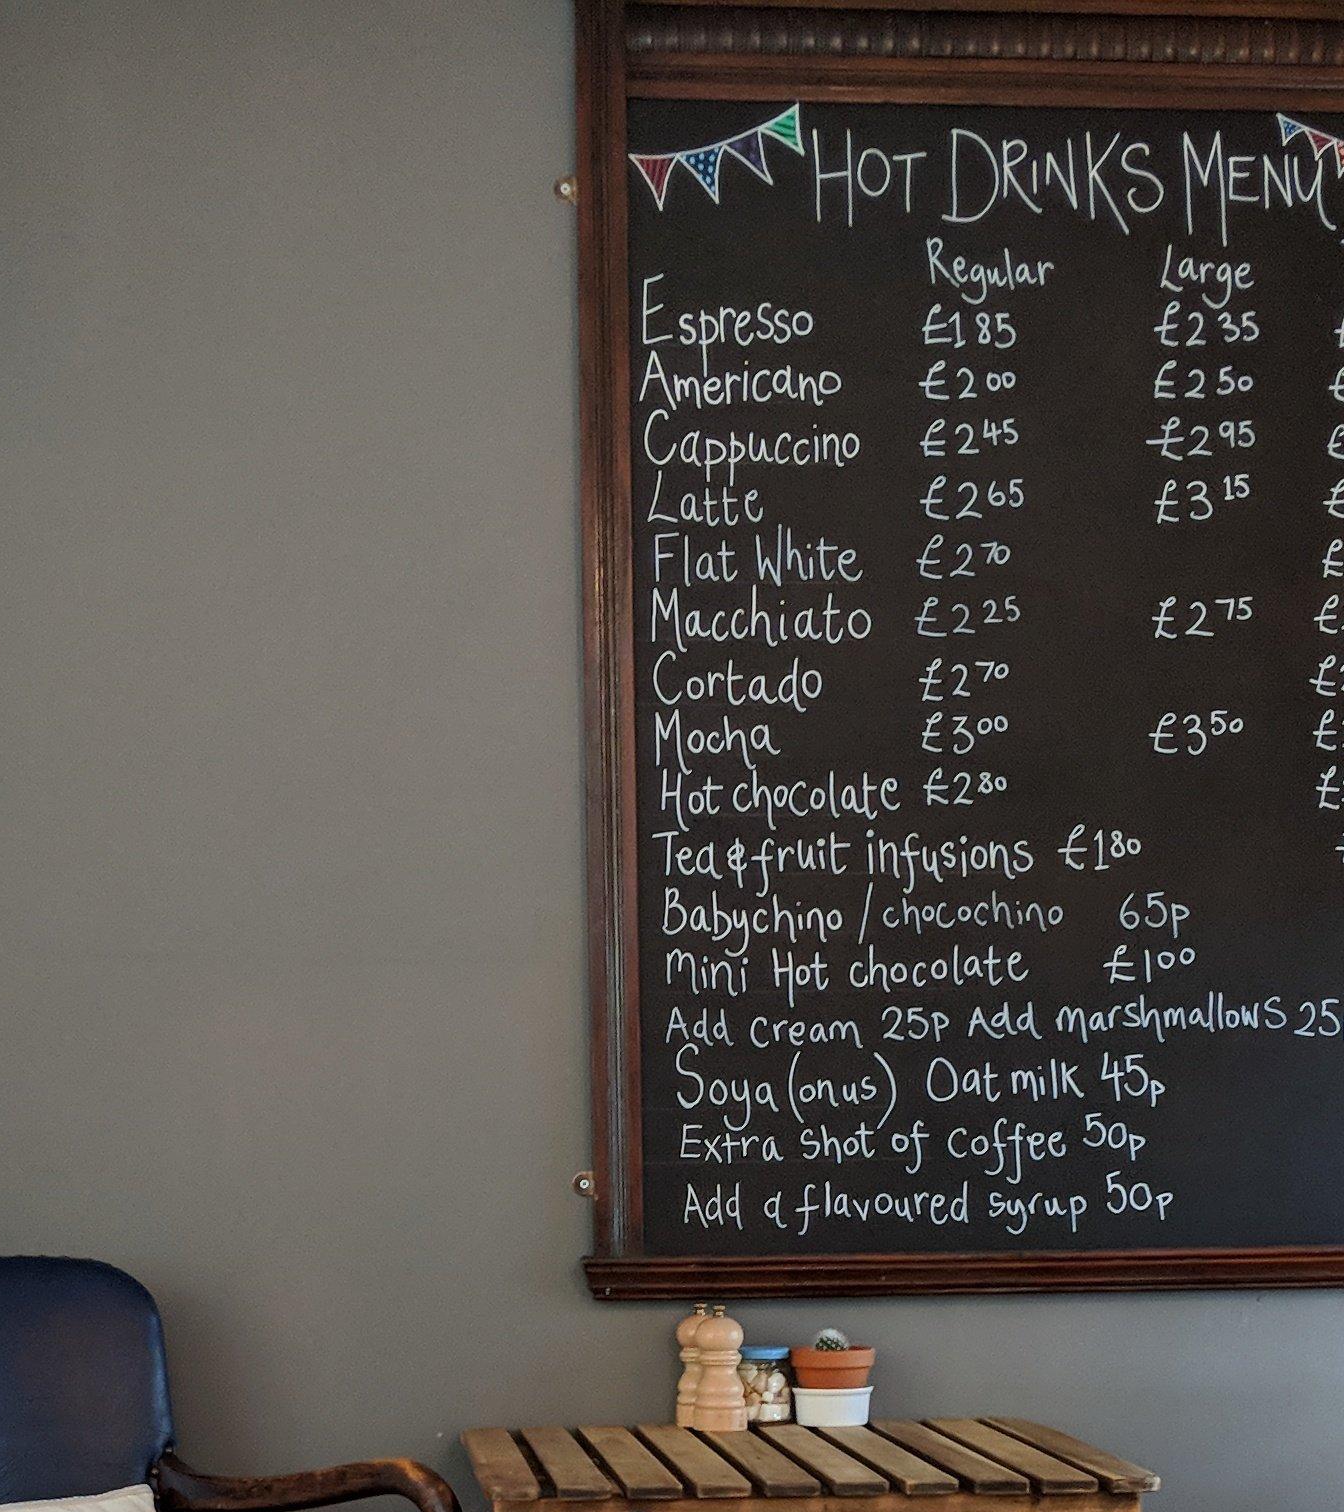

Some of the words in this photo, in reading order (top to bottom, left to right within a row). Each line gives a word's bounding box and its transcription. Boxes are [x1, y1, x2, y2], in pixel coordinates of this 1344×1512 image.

[811, 127, 928, 228] HOT
[1182, 130, 1337, 248] MENU
[925, 236, 1055, 306] Regular
[1159, 243, 1255, 310] Large
[641, 272, 814, 379] Espresso
[921, 302, 1017, 350] £185
[1153, 300, 1260, 348] £235
[638, 349, 842, 411] Americano
[917, 359, 1017, 401] £200
[1153, 359, 1254, 400] £250
[643, 408, 861, 488] Cappuccino
[919, 417, 1020, 458] £245
[1145, 415, 1256, 462] £295
[646, 469, 764, 527] Latte
[919, 474, 1025, 521] £265
[1153, 473, 1251, 525] £315
[654, 531, 739, 588] Flat
[755, 523, 864, 587] White
[915, 533, 1012, 580] £270
[651, 583, 872, 653] Macchiato
[913, 595, 1021, 638] £225
[1151, 595, 1254, 640] £275
[652, 649, 823, 713] Cortado
[918, 657, 1010, 702] £270
[654, 708, 782, 776] Mocha
[921, 711, 1009, 755] £300
[1148, 709, 1244, 756] £350
[660, 768, 724, 833] Hot
[732, 770, 901, 830] chocolate
[922, 766, 1008, 806] £280
[867, 832, 1035, 895] infusions
[1056, 823, 1142, 871] £180
[661, 886, 843, 958] Babychino
[882, 890, 1064, 935] chocochino
[1119, 891, 1191, 939] 65p
[771, 947, 830, 1009] Hot
[849, 943, 1030, 993] chocolate
[1102, 944, 1196, 985] £100
[665, 1006, 735, 1047] Add
[749, 1015, 864, 1049] cream
[967, 1000, 1043, 1040] Add
[675, 1042, 780, 1132] Soya
[926, 1056, 1002, 1103] Oat
[1010, 1057, 1085, 1102] milk
[1100, 1051, 1166, 1108] 45p
[679, 1123, 785, 1165] Extra
[891, 1119, 930, 1175] of
[1082, 1112, 1147, 1162] 50p
[683, 1181, 744, 1231] Add
[763, 1190, 788, 1229] a
[794, 1180, 970, 1236] flavoured
[988, 1191, 1088, 1236] syrup
[1105, 1170, 1174, 1221] 50p
